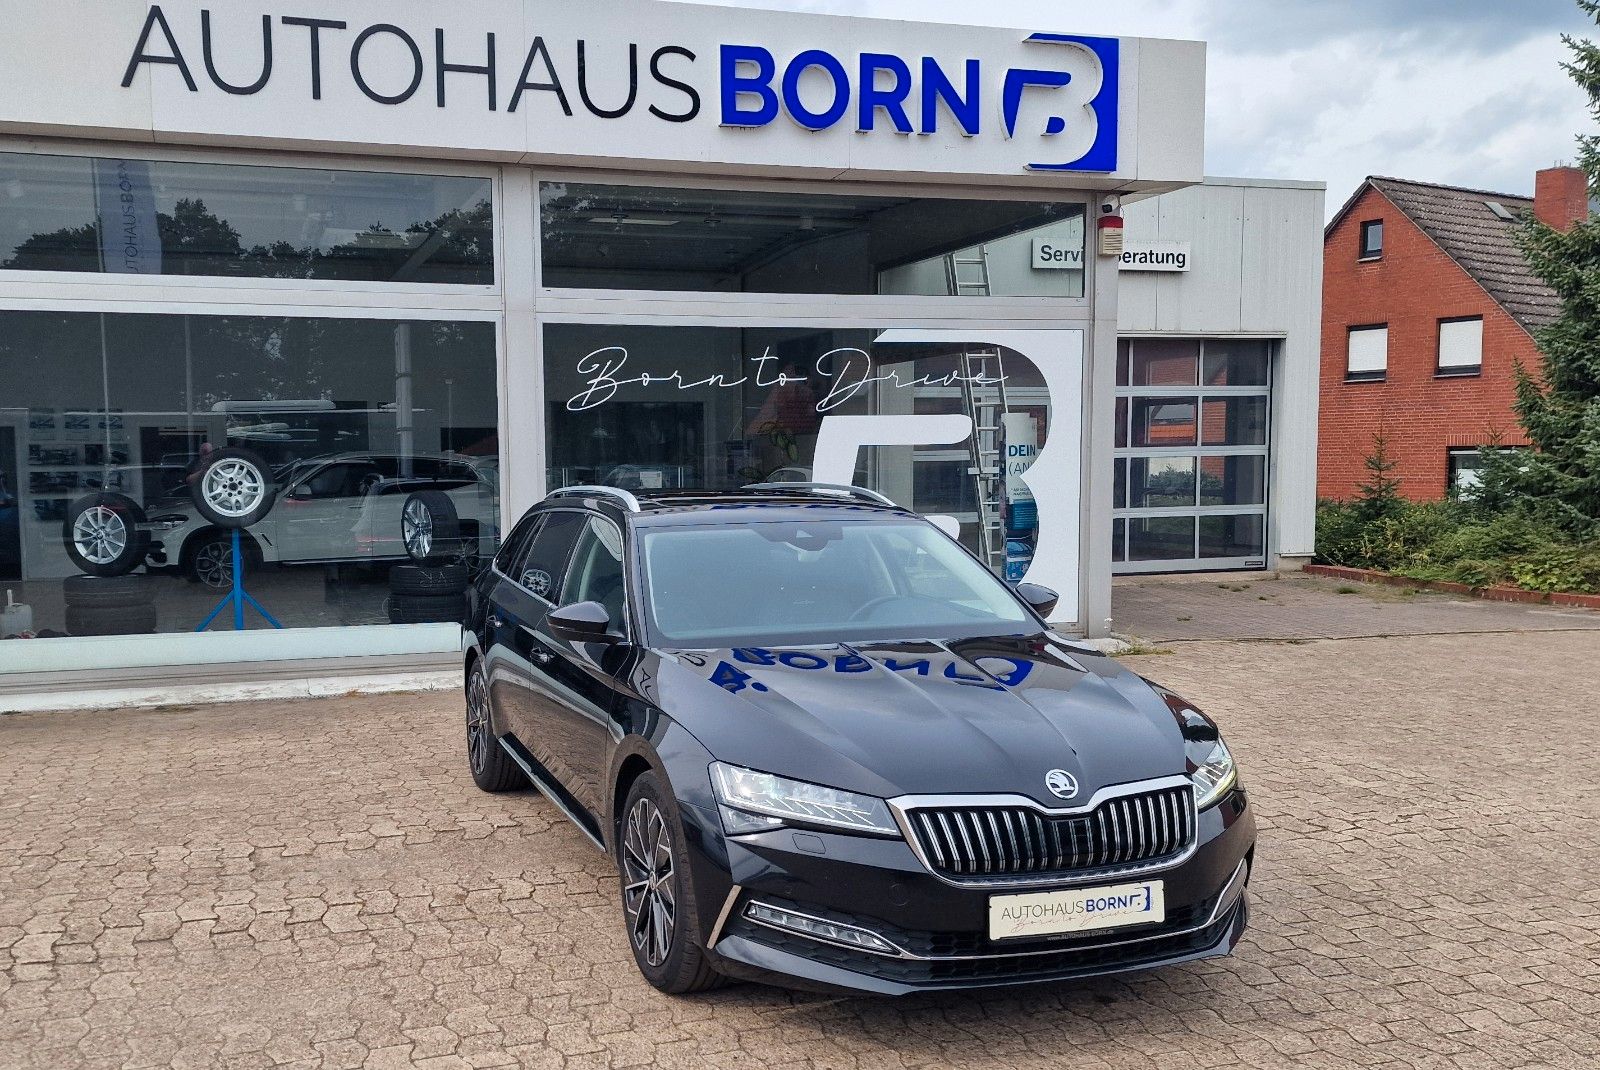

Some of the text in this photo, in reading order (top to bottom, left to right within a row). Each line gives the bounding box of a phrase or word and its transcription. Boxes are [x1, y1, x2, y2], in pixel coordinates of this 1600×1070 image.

[1040, 244, 1186, 268] Servi eratung
[566, 346, 1009, 412] Born to Drive
